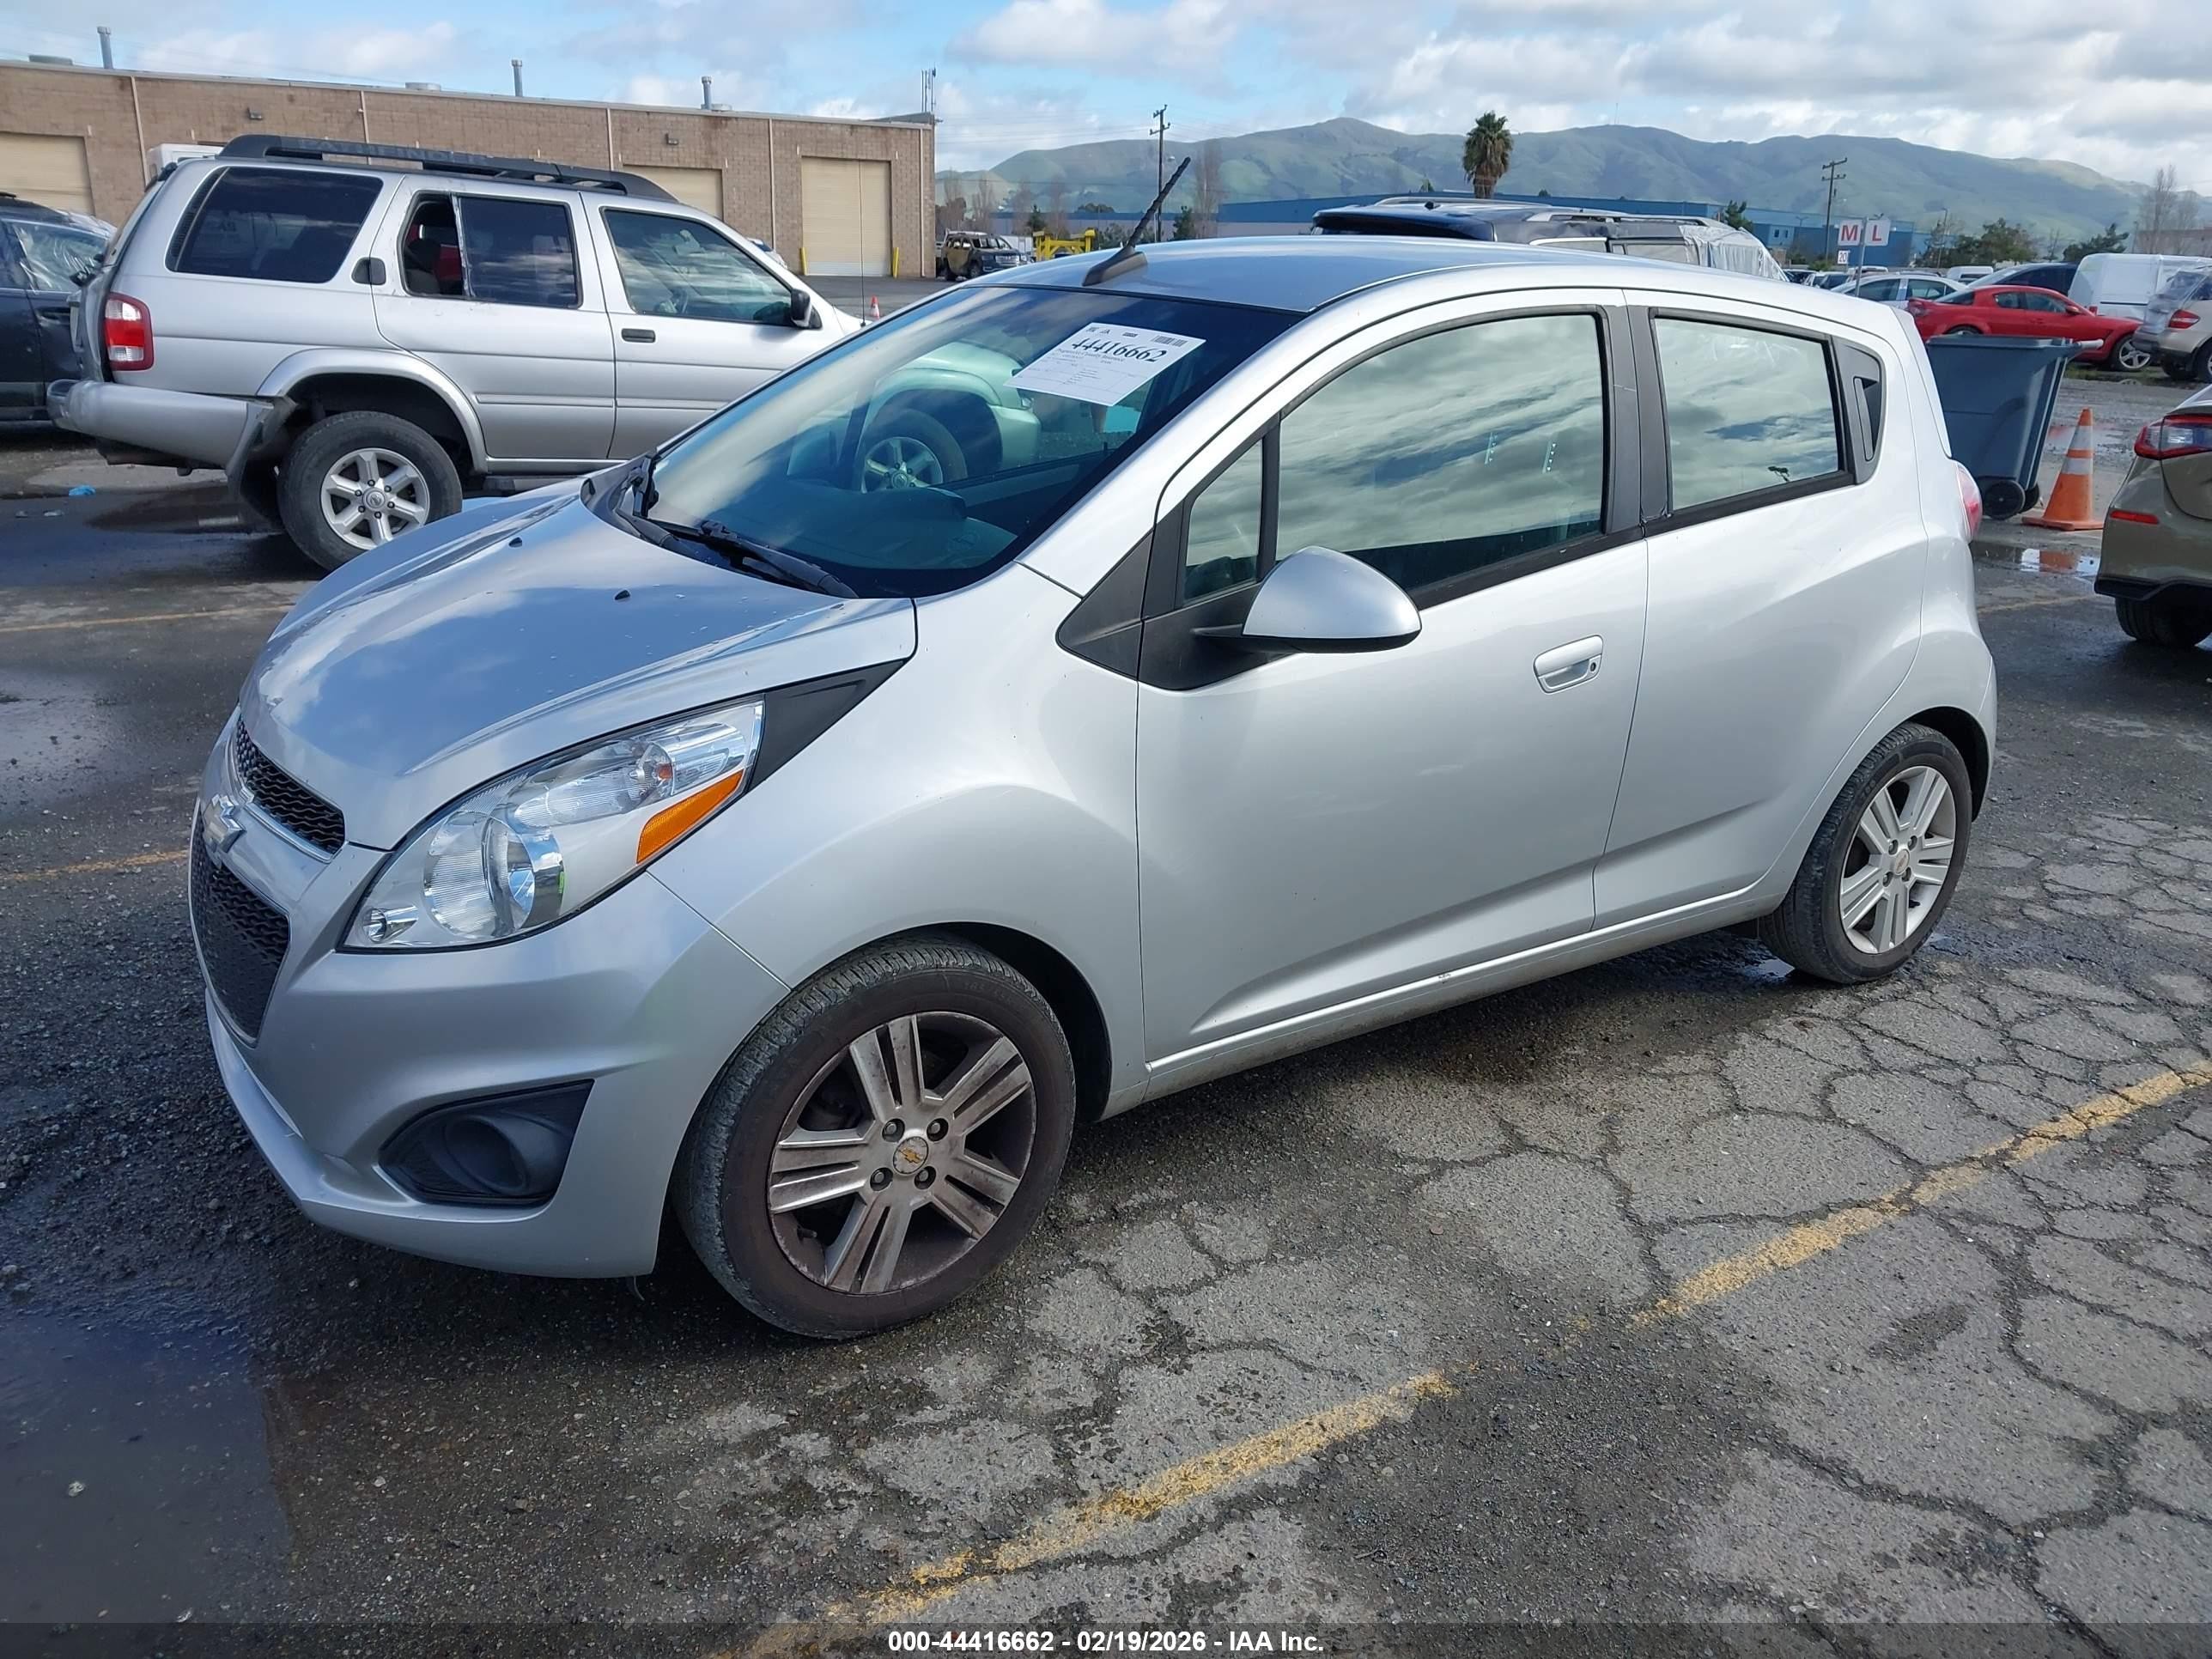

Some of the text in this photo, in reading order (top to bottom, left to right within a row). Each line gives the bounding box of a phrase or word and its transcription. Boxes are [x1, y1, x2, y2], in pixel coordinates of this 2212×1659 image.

[1841, 224, 1859, 241] M
[1873, 224, 1882, 241] L
[1072, 337, 1167, 362] 44416662
